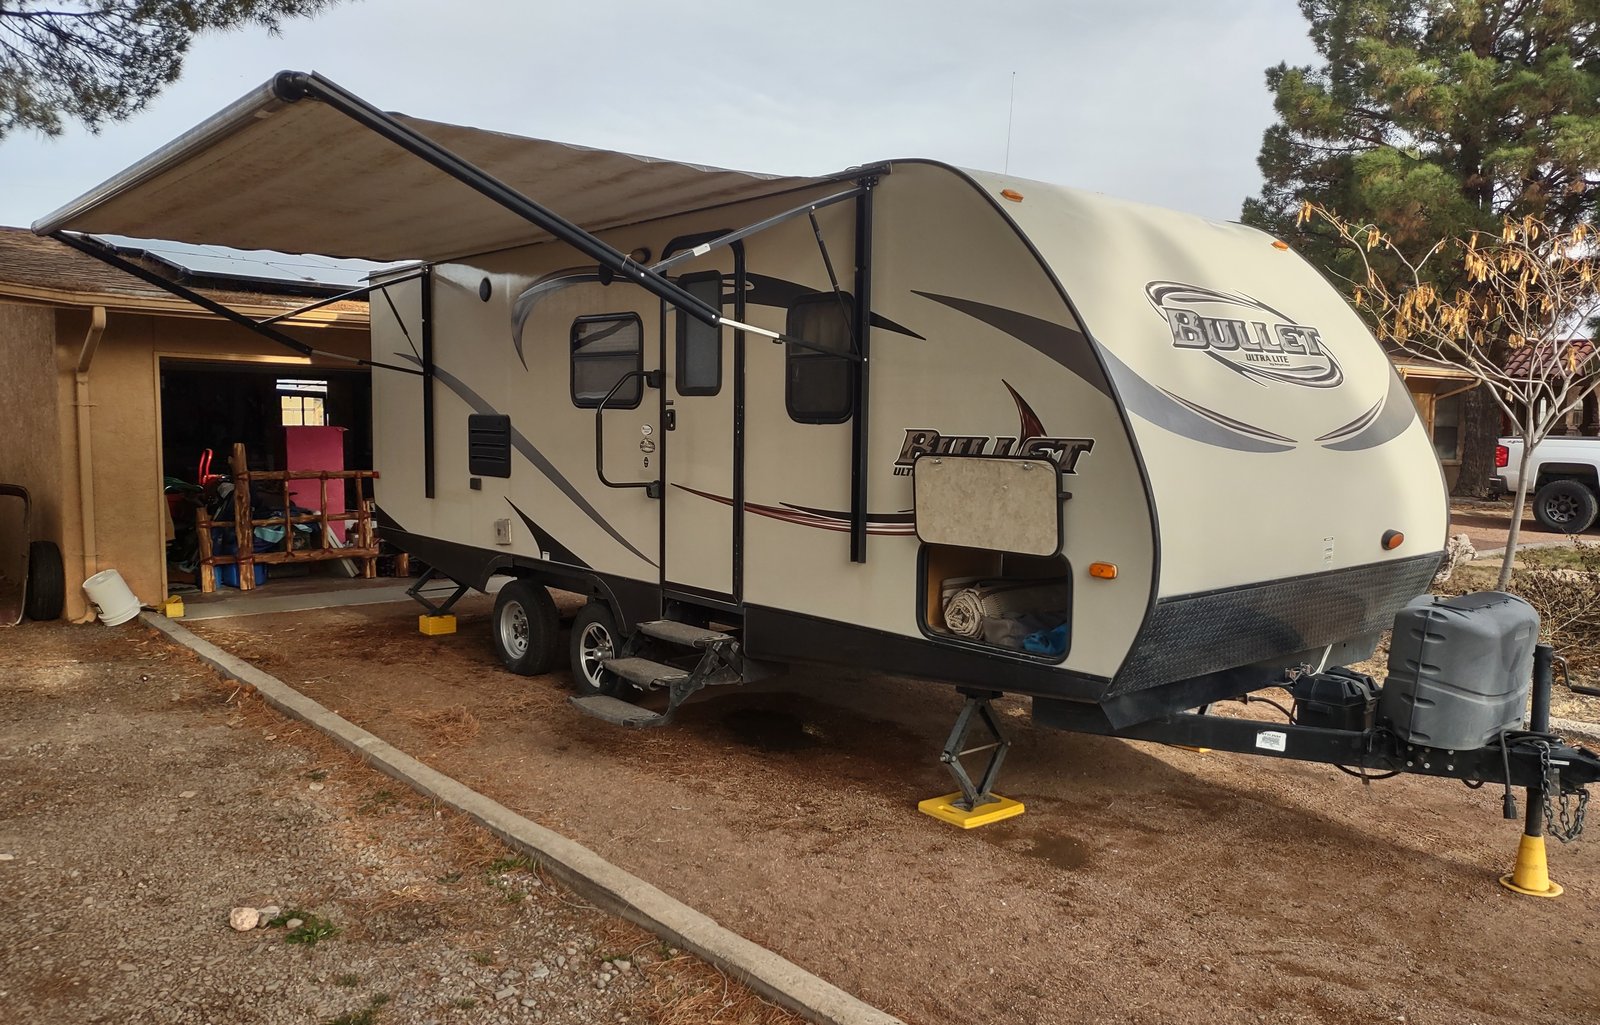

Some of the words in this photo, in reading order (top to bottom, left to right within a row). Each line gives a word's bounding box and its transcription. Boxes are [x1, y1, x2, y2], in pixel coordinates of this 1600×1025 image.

[1162, 306, 1325, 357] BULLET
[1245, 353, 1271, 362] ULTRA
[1272, 355, 1289, 363] LITE
